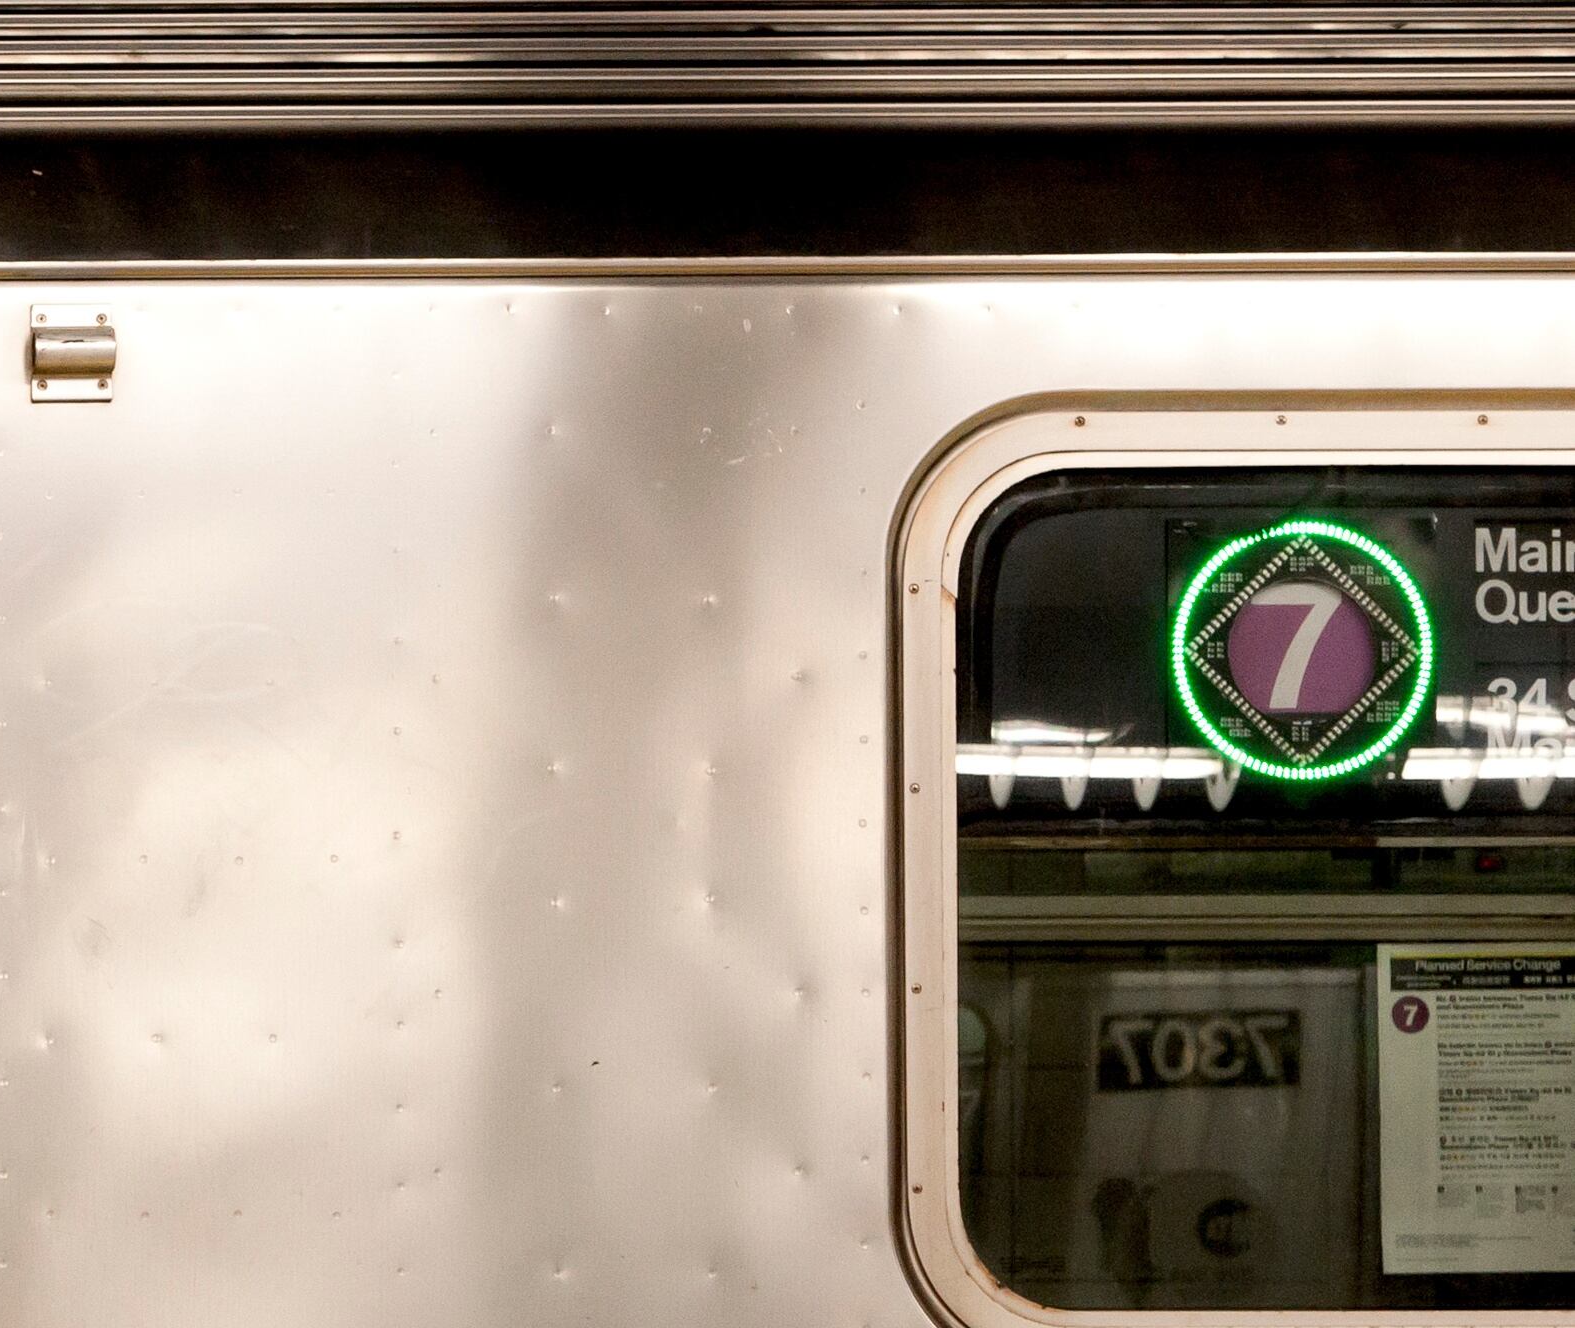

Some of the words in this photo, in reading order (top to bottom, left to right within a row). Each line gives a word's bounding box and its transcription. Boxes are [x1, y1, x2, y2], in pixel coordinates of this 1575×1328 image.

[1249, 581, 1343, 710] 7
[1415, 959, 1465, 972] Planned
[1466, 959, 1512, 971] Service
[1512, 958, 1561, 973] Change
[1403, 1004, 1418, 1027] 7
